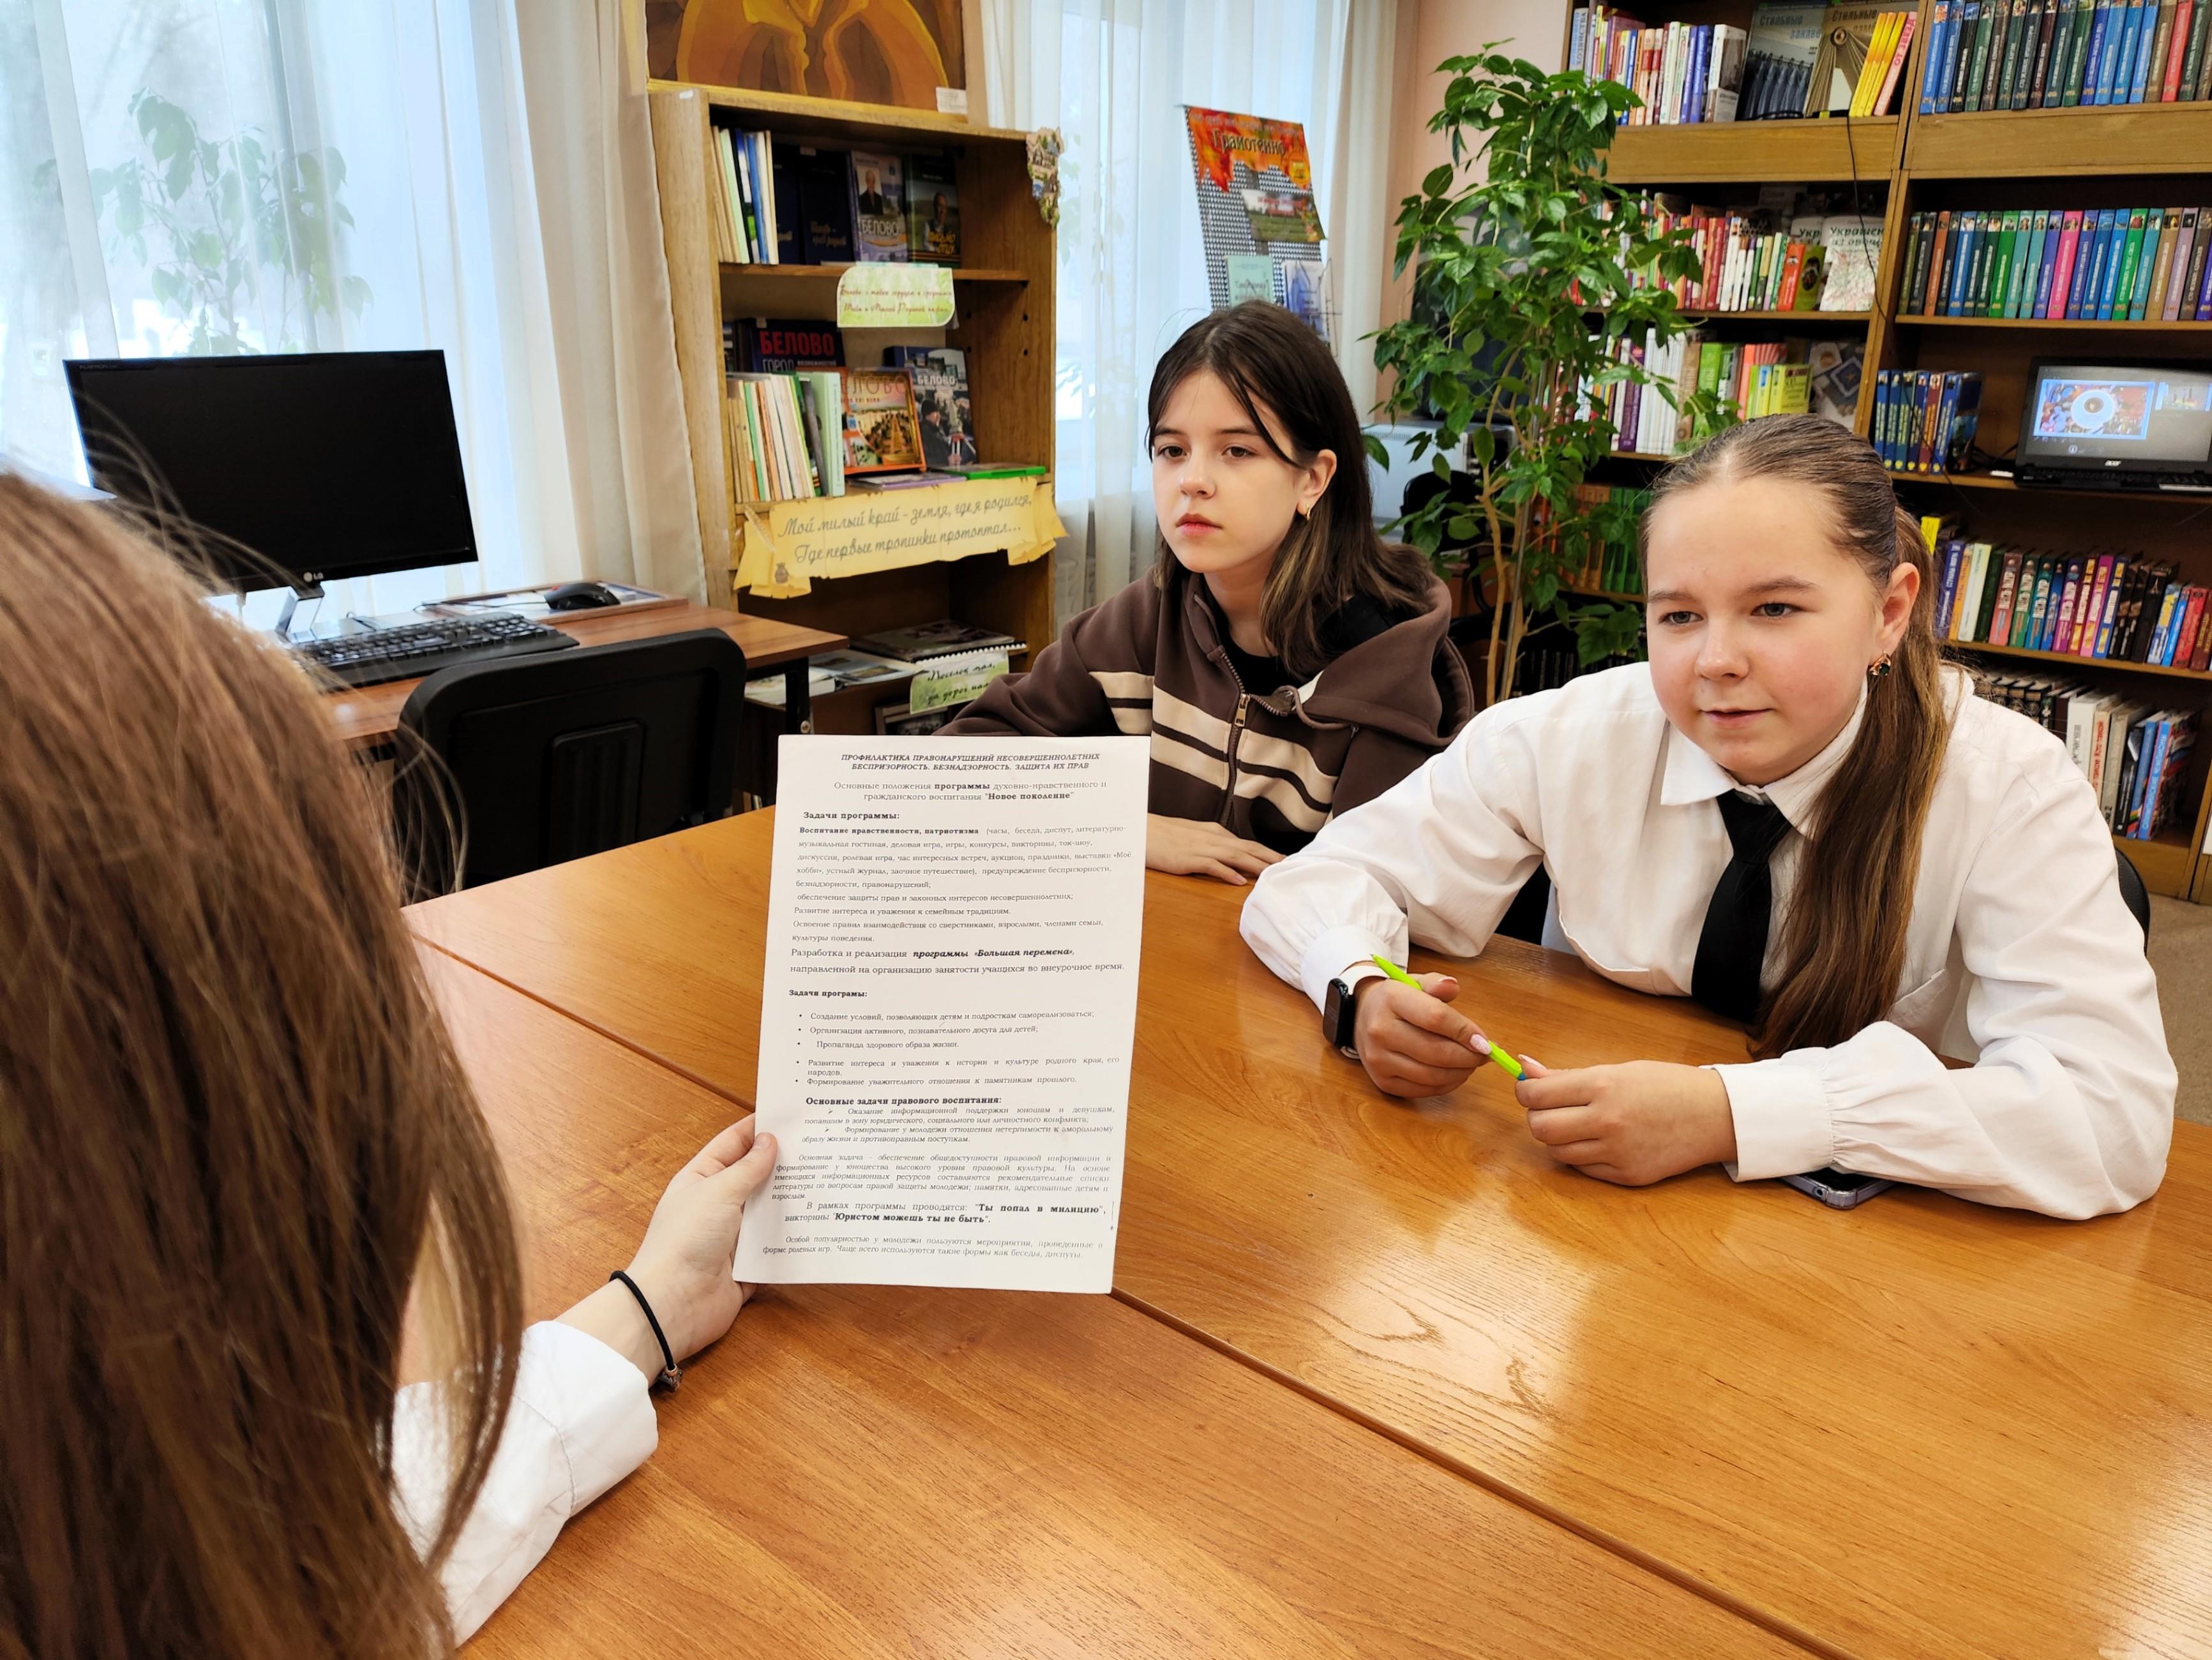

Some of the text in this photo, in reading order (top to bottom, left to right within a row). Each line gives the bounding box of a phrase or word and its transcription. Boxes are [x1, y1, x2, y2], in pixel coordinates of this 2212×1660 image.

[1759, 13, 1804, 27] Стильные
[1832, 9, 1878, 22] Стильные
[759, 330, 836, 357] БЕЛОВО
[917, 374, 956, 385] БЕЛОВО
[841, 375, 907, 395] ЕЛОВО
[777, 516, 815, 537] Мой
[817, 511, 866, 532] милый
[868, 505, 901, 528] край
[910, 505, 951, 525] земля,
[954, 502, 972, 517] где
[983, 494, 1032, 514] родился,
[794, 544, 824, 565] Где
[825, 537, 873, 562] первые
[875, 528, 938, 554] тропинки
[841, 753, 1100, 762] ПРОФИЛАКТИКА ПРАВОНАРУШЕНИЙ НЕСОВЕРШЕННОЛЕТНИХ
[934, 783, 991, 791] программы
[992, 782, 1099, 791] духовно-нравственного
[864, 794, 927, 802] гражданского
[803, 811, 838, 819] Задачи
[986, 827, 1010, 835] (часы,
[969, 842, 1009, 850] конкурсы,
[991, 855, 1026, 863] аукцион,
[1027, 854, 1072, 862] праздники,
[825, 867, 855, 876] устный
[857, 868, 889, 877] журнал,
[922, 867, 977, 876] путешествие),
[982, 867, 1046, 877] предупреждение
[795, 879, 931, 890] безнадзорности, правонарушений;
[797, 893, 846, 901] обеспечение
[949, 895, 988, 903] интересов
[990, 894, 1073, 902] несовершеннолетних;
[877, 909, 916, 917] уважения
[832, 922, 861, 931] правил
[938, 922, 996, 931] сверстниками,
[998, 922, 1042, 930] взрослыми,
[792, 935, 829, 943] культуры
[791, 948, 843, 959] Разработка
[854, 951, 907, 959] реализация
[913, 951, 969, 959] программы
[790, 965, 856, 975] направленной
[981, 966, 1025, 975] учащихся
[1041, 964, 1092, 974] внеурочное
[816, 1040, 864, 1050] Пропаганда
[905, 1041, 931, 1050] образа
[806, 1097, 855, 1105] Основные
[891, 1098, 940, 1107] правового
[785, 1215, 829, 1223] викторины
